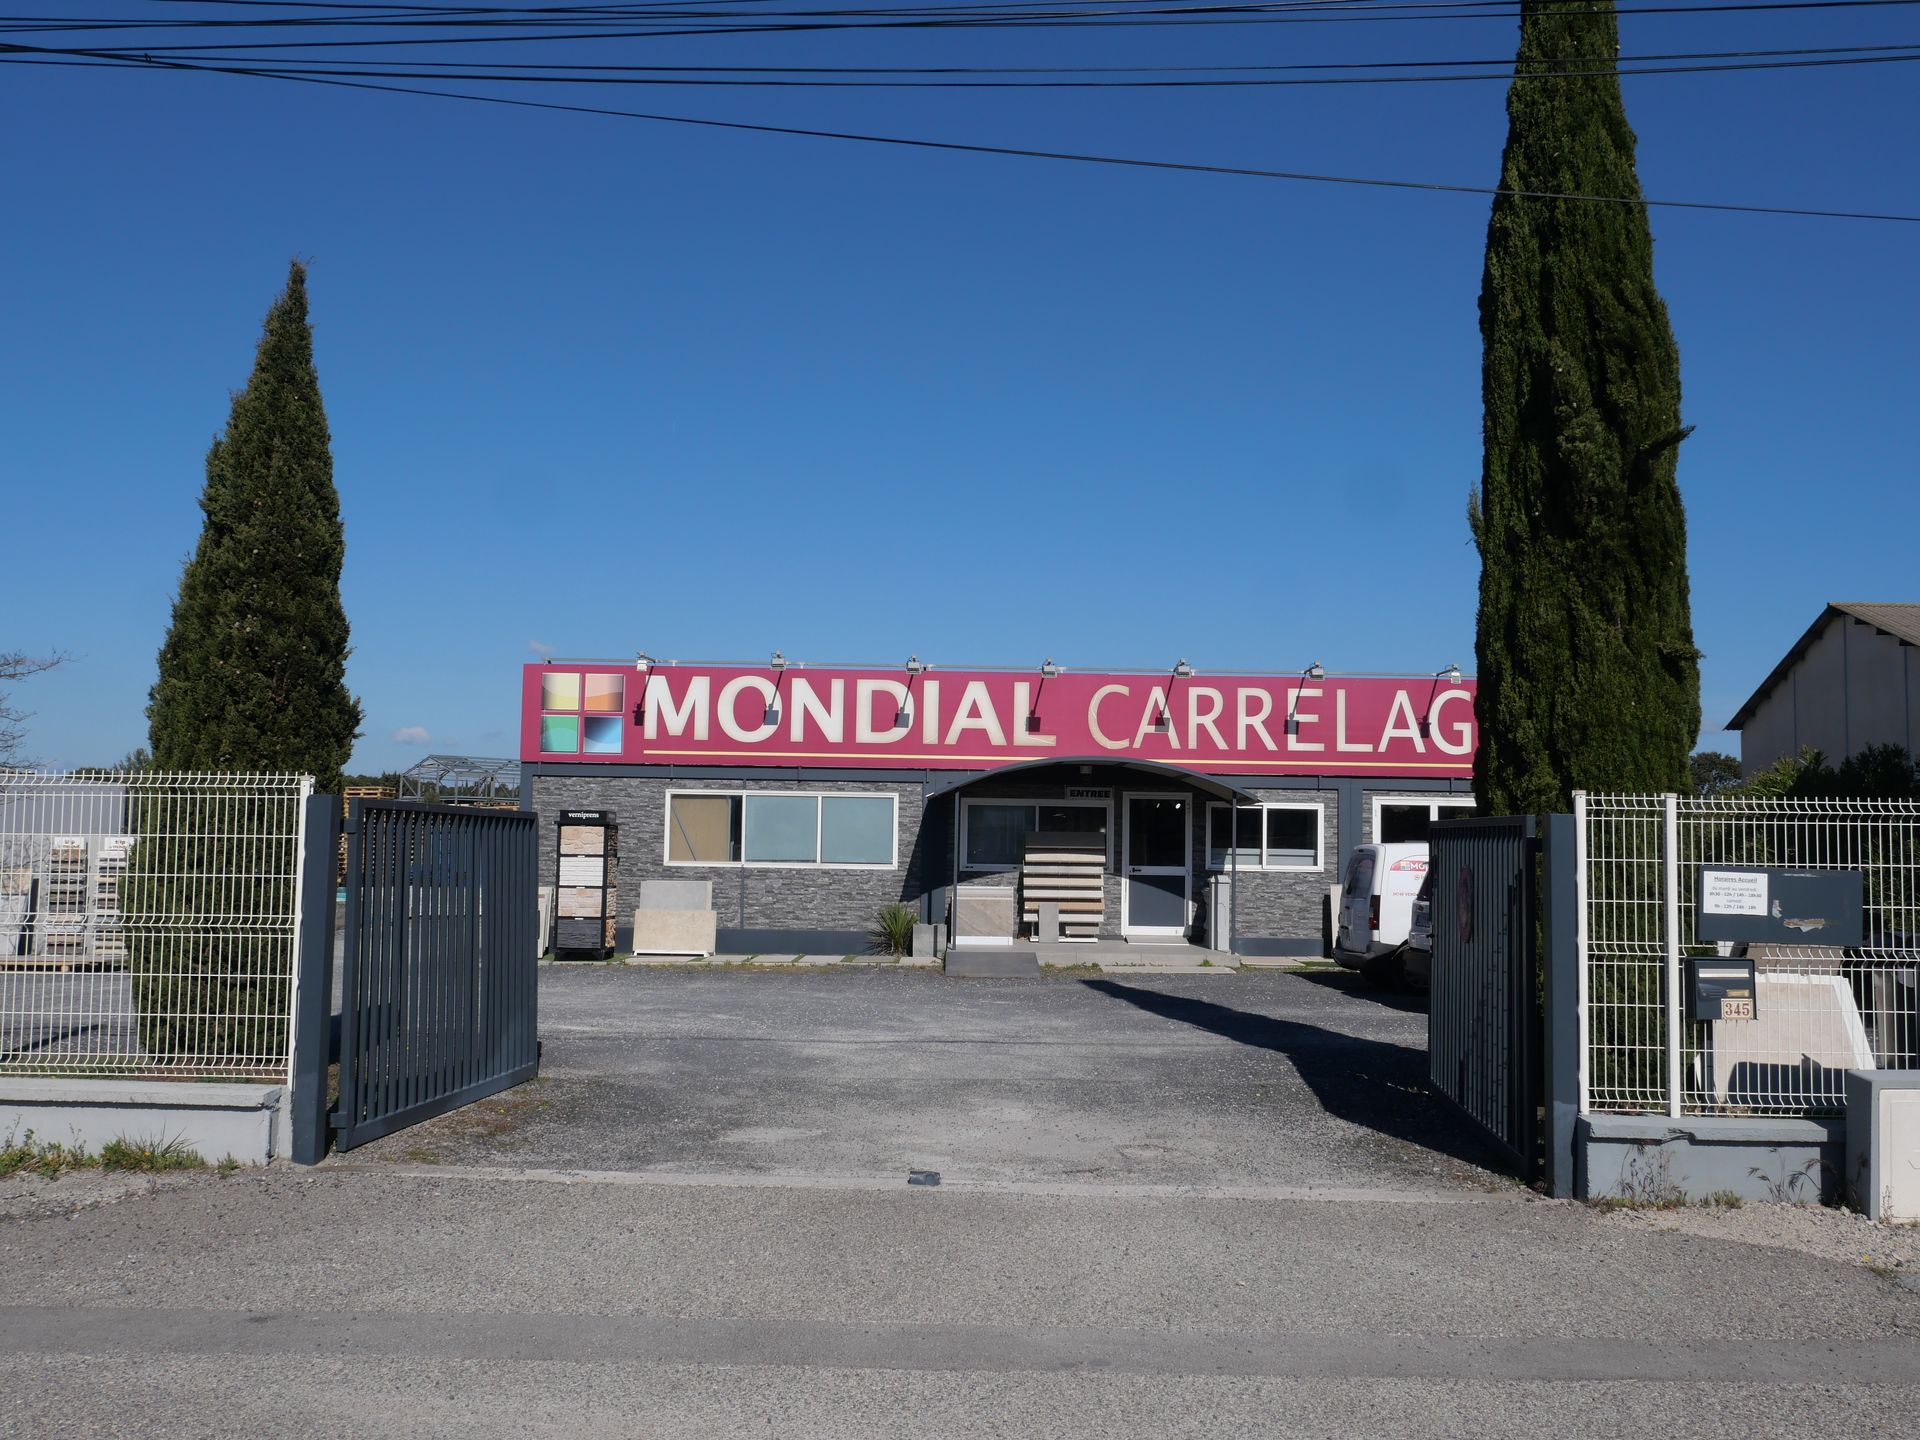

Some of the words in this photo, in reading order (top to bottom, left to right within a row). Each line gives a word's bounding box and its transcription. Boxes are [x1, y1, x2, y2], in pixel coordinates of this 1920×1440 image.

[643, 674, 1056, 747] MONDIAL
[1087, 683, 1473, 755] CARRELAG
[1069, 789, 1111, 798] ENTREE
[1725, 1003, 1750, 1016] 345
